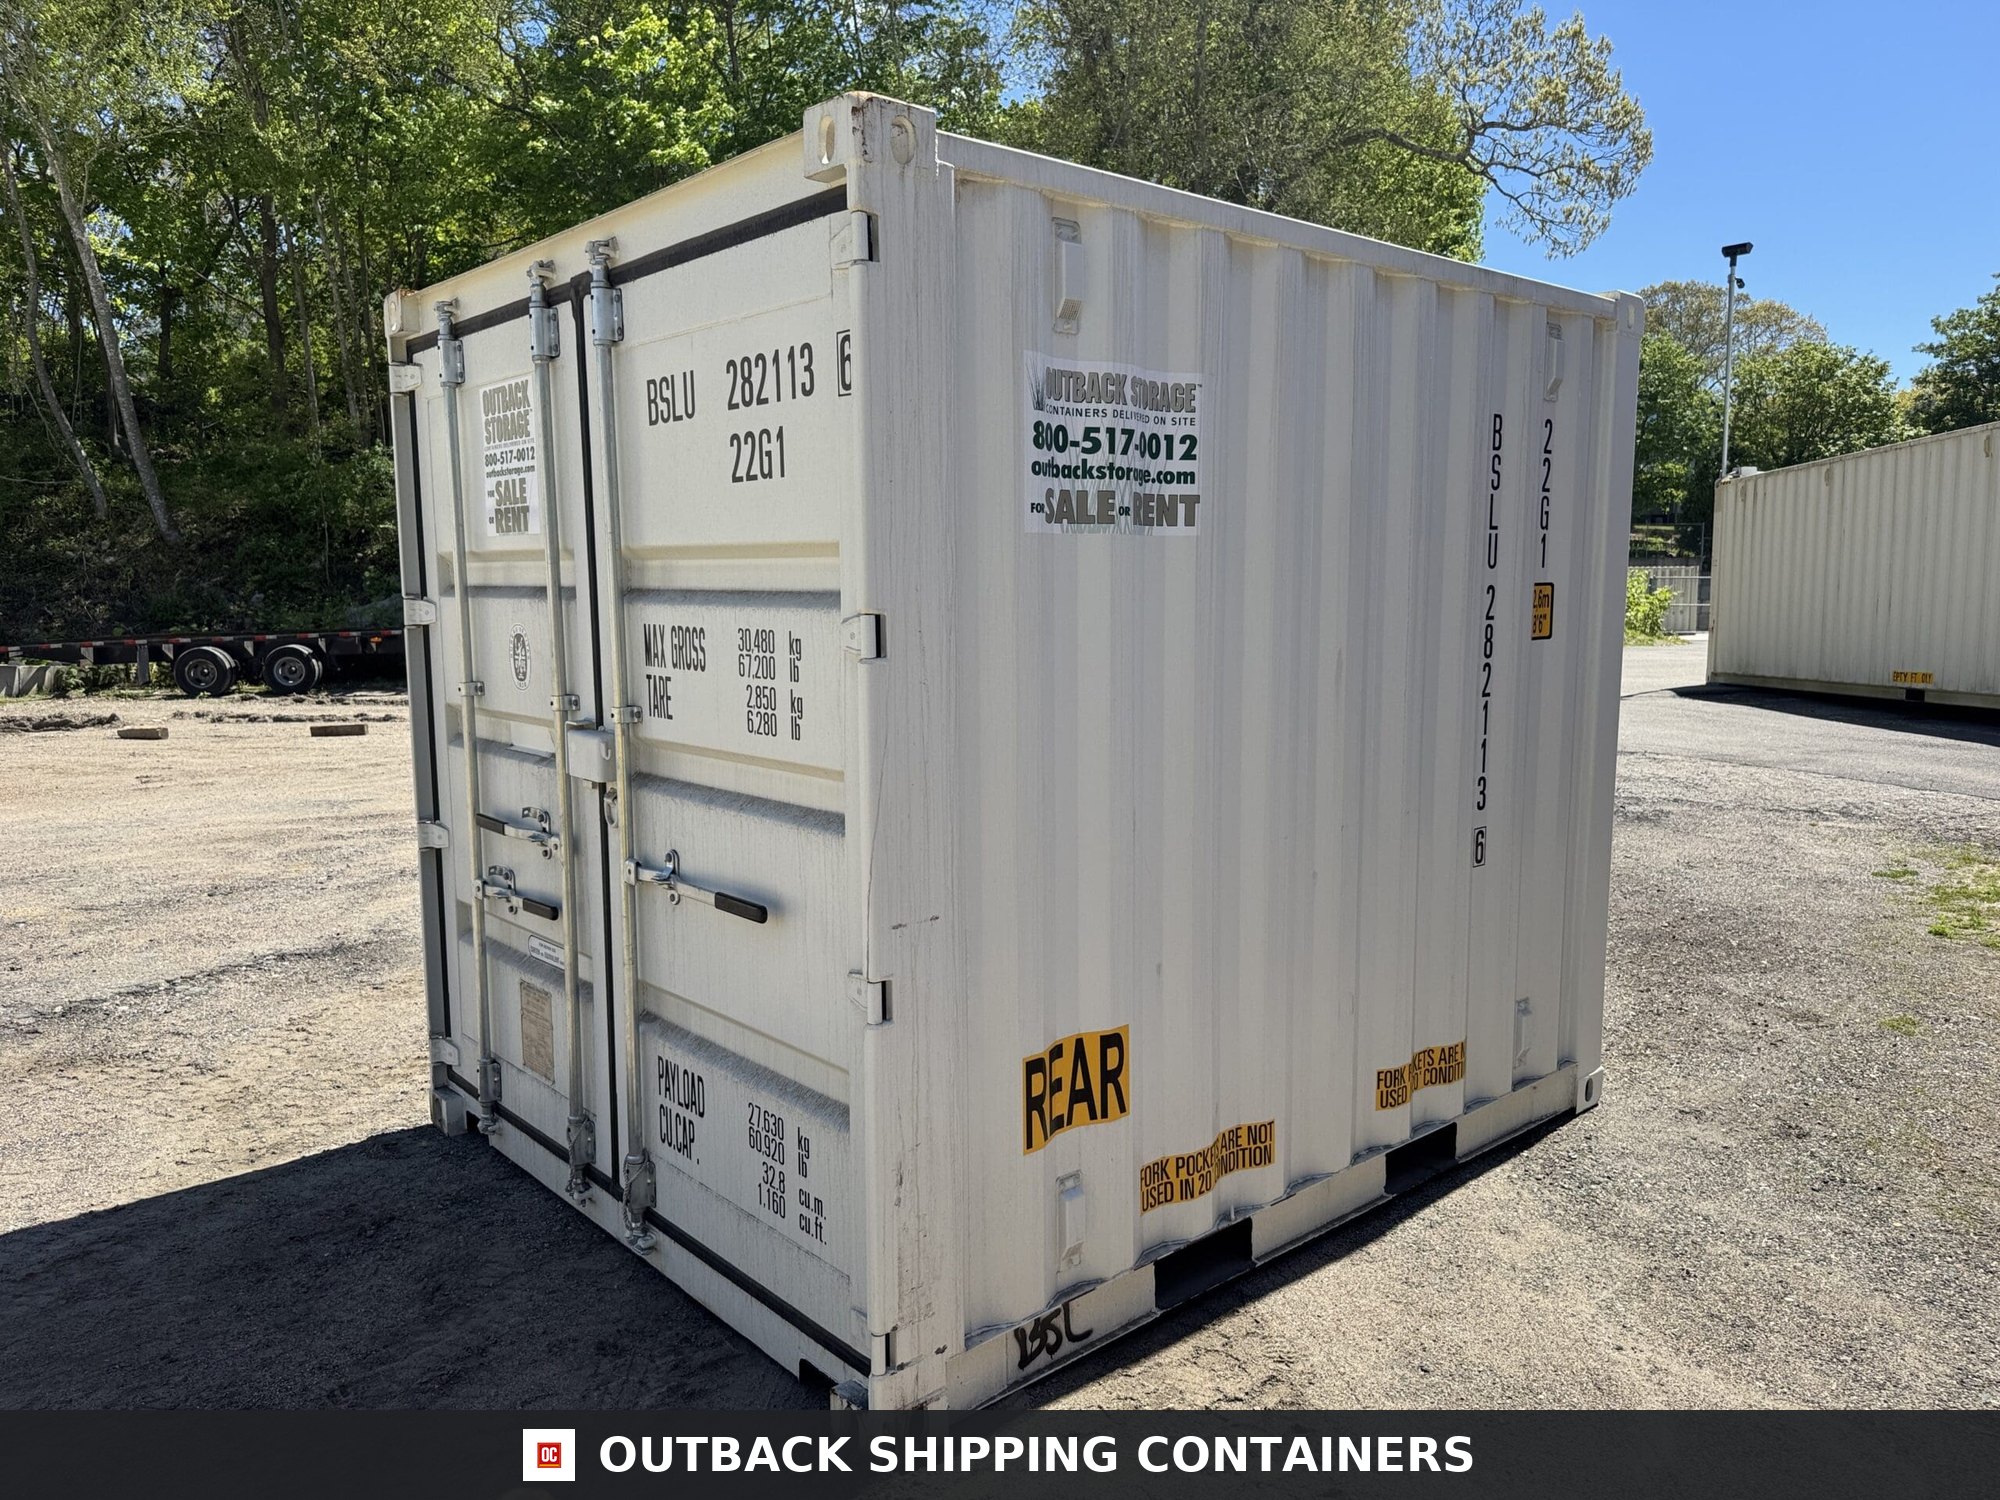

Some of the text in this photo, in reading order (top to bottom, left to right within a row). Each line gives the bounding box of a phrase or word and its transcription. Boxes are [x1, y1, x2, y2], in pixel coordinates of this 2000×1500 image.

[482, 380, 531, 417] OUTBACK
[647, 334, 851, 426] BSLU 282113 6
[1046, 366, 1197, 413] OUTBACK STORAGE
[484, 409, 531, 445] STORAGE
[1045, 404, 1196, 426] CONTAINERS DELIVERED ON SITE
[484, 445, 535, 467] 800-517-0012
[729, 426, 785, 483] 22G1
[1032, 420, 1198, 461] 800-517-0012
[1031, 457, 1196, 486] outbackstorage.com
[495, 477, 527, 507] SALE
[1030, 487, 1201, 527] FOR SALE OR RENT
[1539, 418, 1553, 569] 22G1
[495, 506, 530, 534] RENT
[643, 623, 667, 668] MAX
[670, 625, 706, 672] GROSS
[788, 630, 802, 661] kg
[1474, 413, 1503, 866] BSLU 282113 6
[789, 657, 800, 683] lb
[646, 674, 673, 720] TARE
[790, 688, 803, 720] kg
[791, 715, 801, 741] lb
[657, 1055, 705, 1118] PAYLOAD
[1377, 1066, 1406, 1090] FORK
[1438, 1044, 1459, 1066] ARE
[1380, 1085, 1408, 1109] USED
[1423, 1061, 1464, 1087] CONDITI
[1025, 1031, 1127, 1150] REAR
[797, 1127, 810, 1159] kg
[1140, 1158, 1170, 1192] FORK
[1220, 1127, 1243, 1154] ARE
[1247, 1120, 1275, 1146] NOT
[762, 1161, 786, 1195] 32.8
[797, 1152, 808, 1178] lb
[1141, 1181, 1174, 1212] USED
[1180, 1177, 1195, 1201] IN
